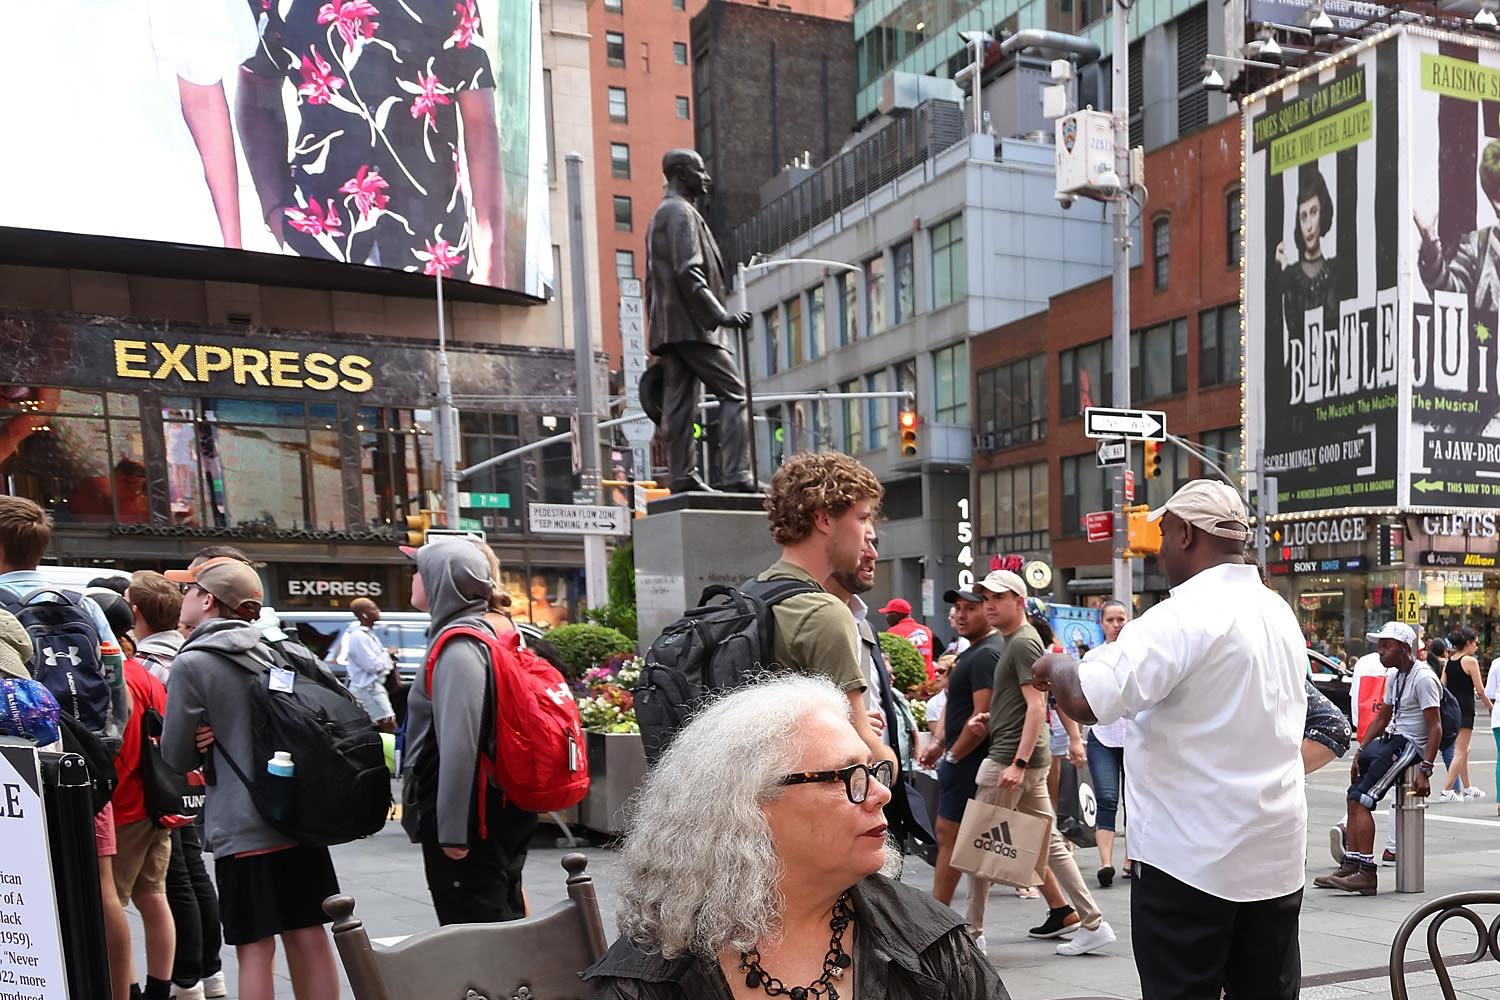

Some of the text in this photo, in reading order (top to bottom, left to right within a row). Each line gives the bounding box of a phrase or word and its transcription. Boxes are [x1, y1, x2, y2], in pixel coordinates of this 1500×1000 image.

[1432, 63, 1486, 94] RAISING
[1255, 70, 1363, 144] TIMES SQUARE CAN REALLY
[1274, 109, 1370, 167] MAKE YOU FEEL ALIVE!
[1290, 303, 1397, 405] BEETLE
[113, 339, 375, 393] EXPRESS
[1316, 407, 1328, 421] The
[1358, 398, 1370, 413] The
[1411, 395, 1431, 411] The
[1319, 443, 1341, 464] GOOD
[1447, 482, 1462, 493] THIS
[1463, 482, 1479, 494] WAY
[1480, 483, 1490, 495] TO
[534, 507, 617, 520] PEDESTRIAN FLOW ZONE
[554, 521, 581, 530] MOVING
[1283, 517, 1367, 546] LUGGAGE
[1423, 514, 1496, 538] GIFTS
[1294, 561, 1317, 572] SONY
[1435, 553, 1457, 566] Apple
[1463, 553, 1495, 567] Nikon
[288, 580, 382, 596] EXPRESS
[1408, 592, 1417, 620] ATM
[973, 838, 1018, 859] adidas
[4, 892, 25, 905] of A
[19, 974, 47, 987] more
